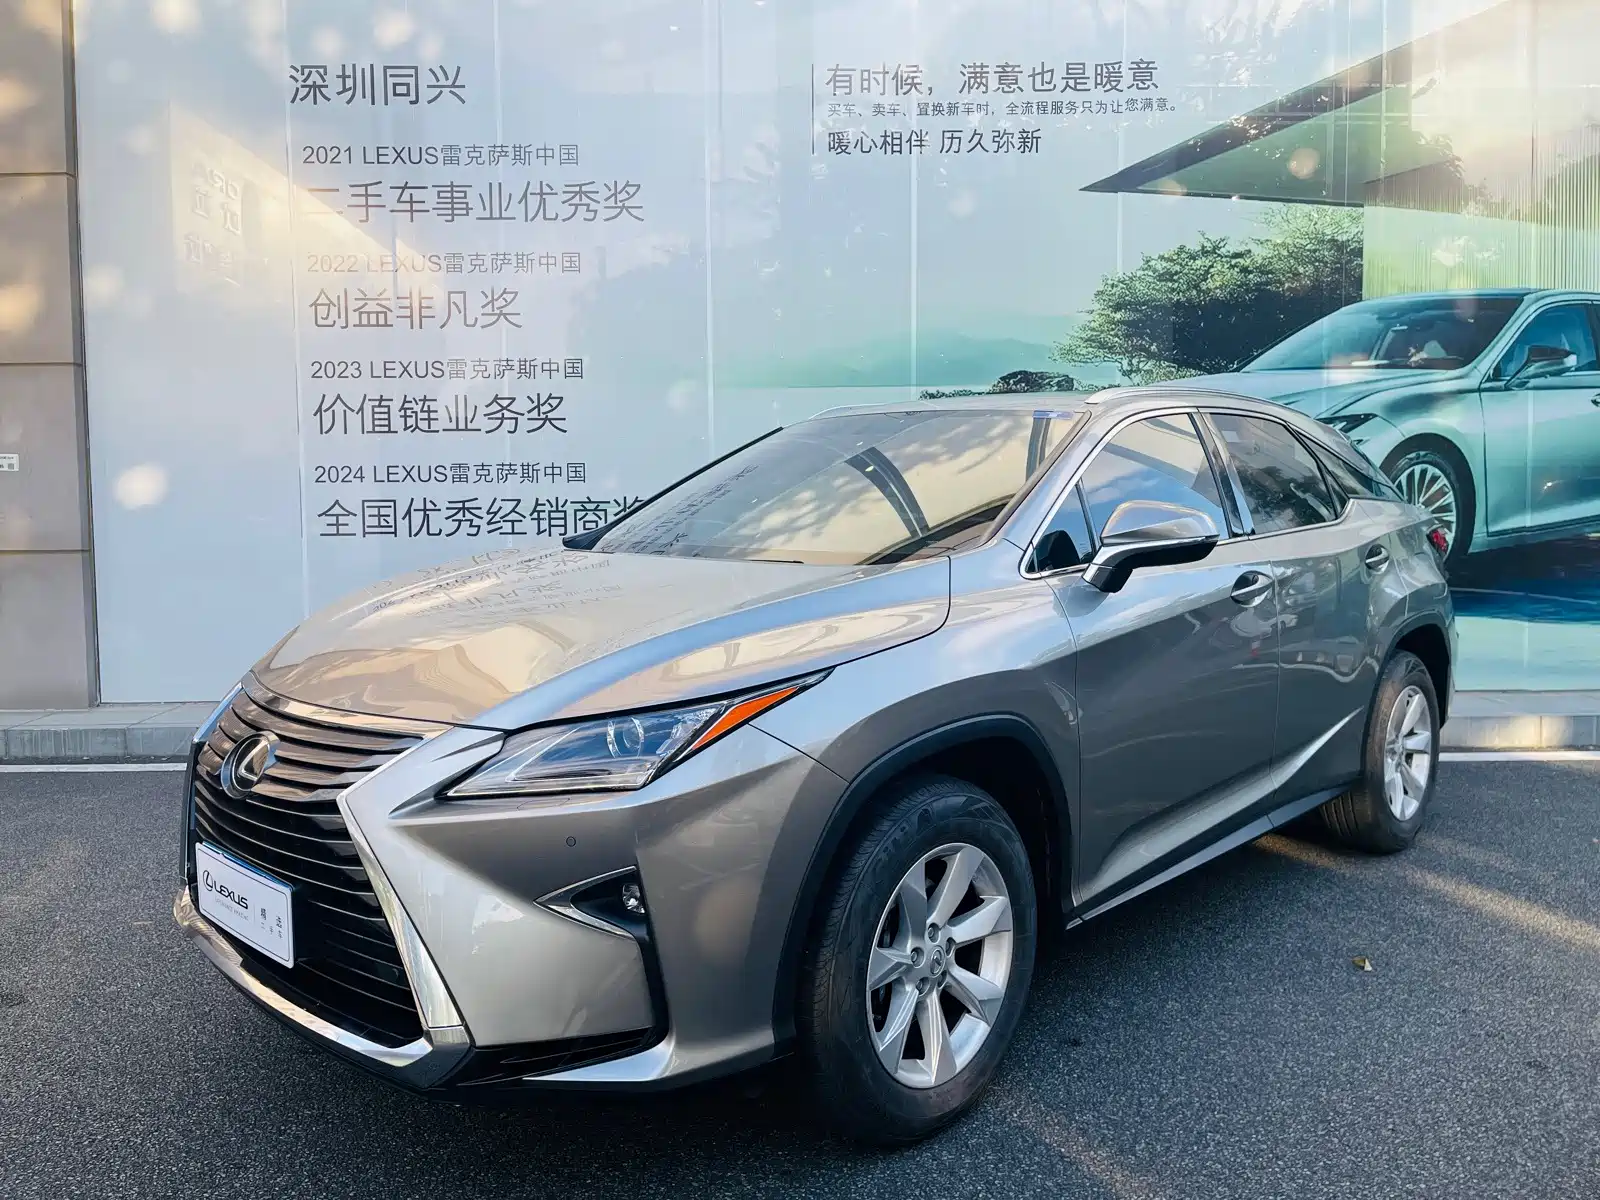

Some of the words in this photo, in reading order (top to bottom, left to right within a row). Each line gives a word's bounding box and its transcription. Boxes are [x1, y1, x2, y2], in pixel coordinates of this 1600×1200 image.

[288, 62, 467, 106] 深圳同兴
[825, 58, 1159, 97] 有时候，满意也是暖意
[302, 145, 352, 165] 2021
[363, 143, 580, 167] LEXUS雷克萨斯中国
[827, 129, 929, 156] 暖心相伴
[939, 127, 1042, 155] 历久弥新
[302, 179, 645, 224] 二手车事业优秀奖
[307, 253, 359, 274] 2022
[367, 251, 582, 275] LEXUS雷克萨斯中国
[308, 285, 523, 331] 创益非凡奖
[310, 359, 363, 380] 2023
[370, 357, 584, 381] LEXUS雷克萨斯中国
[312, 391, 568, 435] 价值链业务奖
[314, 464, 366, 484] 2024
[373, 461, 587, 485] LEXUS雷克萨斯中国
[213, 880, 248, 910] LEXUS
